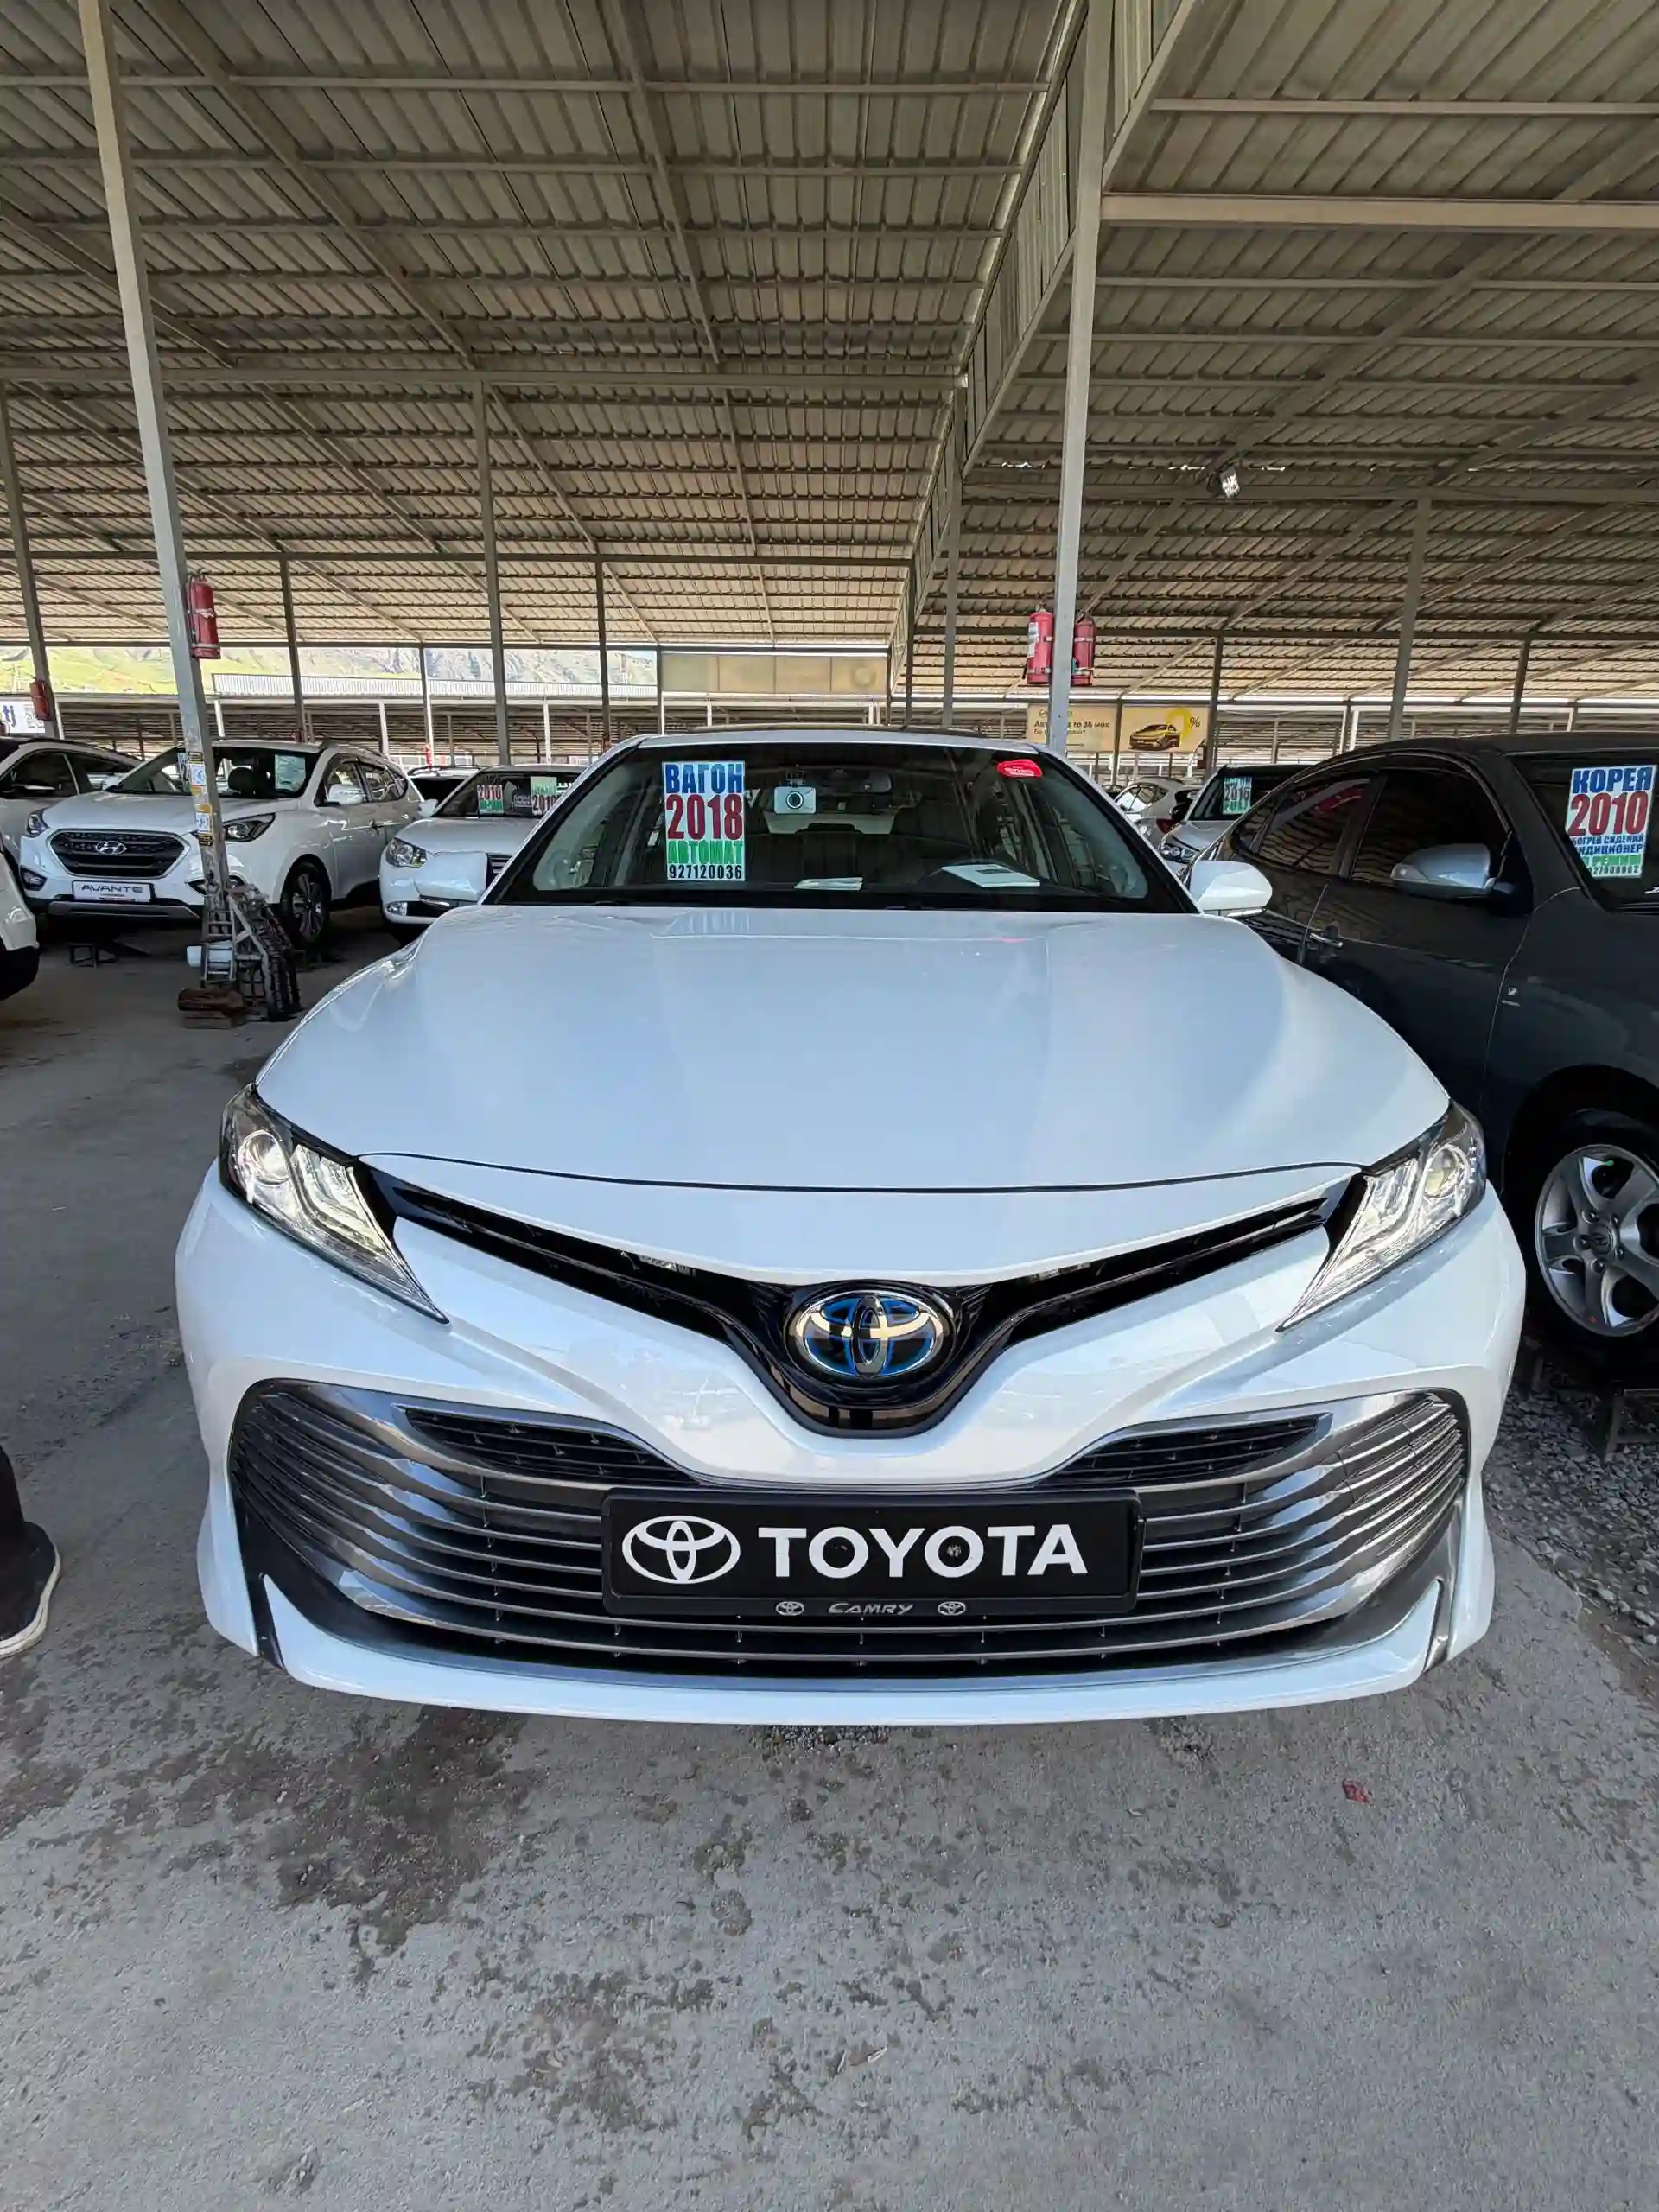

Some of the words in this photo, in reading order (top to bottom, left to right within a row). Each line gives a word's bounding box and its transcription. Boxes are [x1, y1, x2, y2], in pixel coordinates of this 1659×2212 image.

[664, 764, 743, 793] ВАГОН
[1573, 767, 1653, 793] КОРЕЯ
[665, 794, 743, 840] 2018
[1567, 791, 1649, 836] 2010
[1573, 836, 1602, 847] БОГРЕВ
[1579, 844, 1643, 856] НДИЦИОНЕР
[669, 865, 742, 879] 927120036
[81, 884, 144, 893] AVANTE
[758, 1524, 1089, 1580] TOYOTA
[829, 1603, 913, 1616] CAMRY
